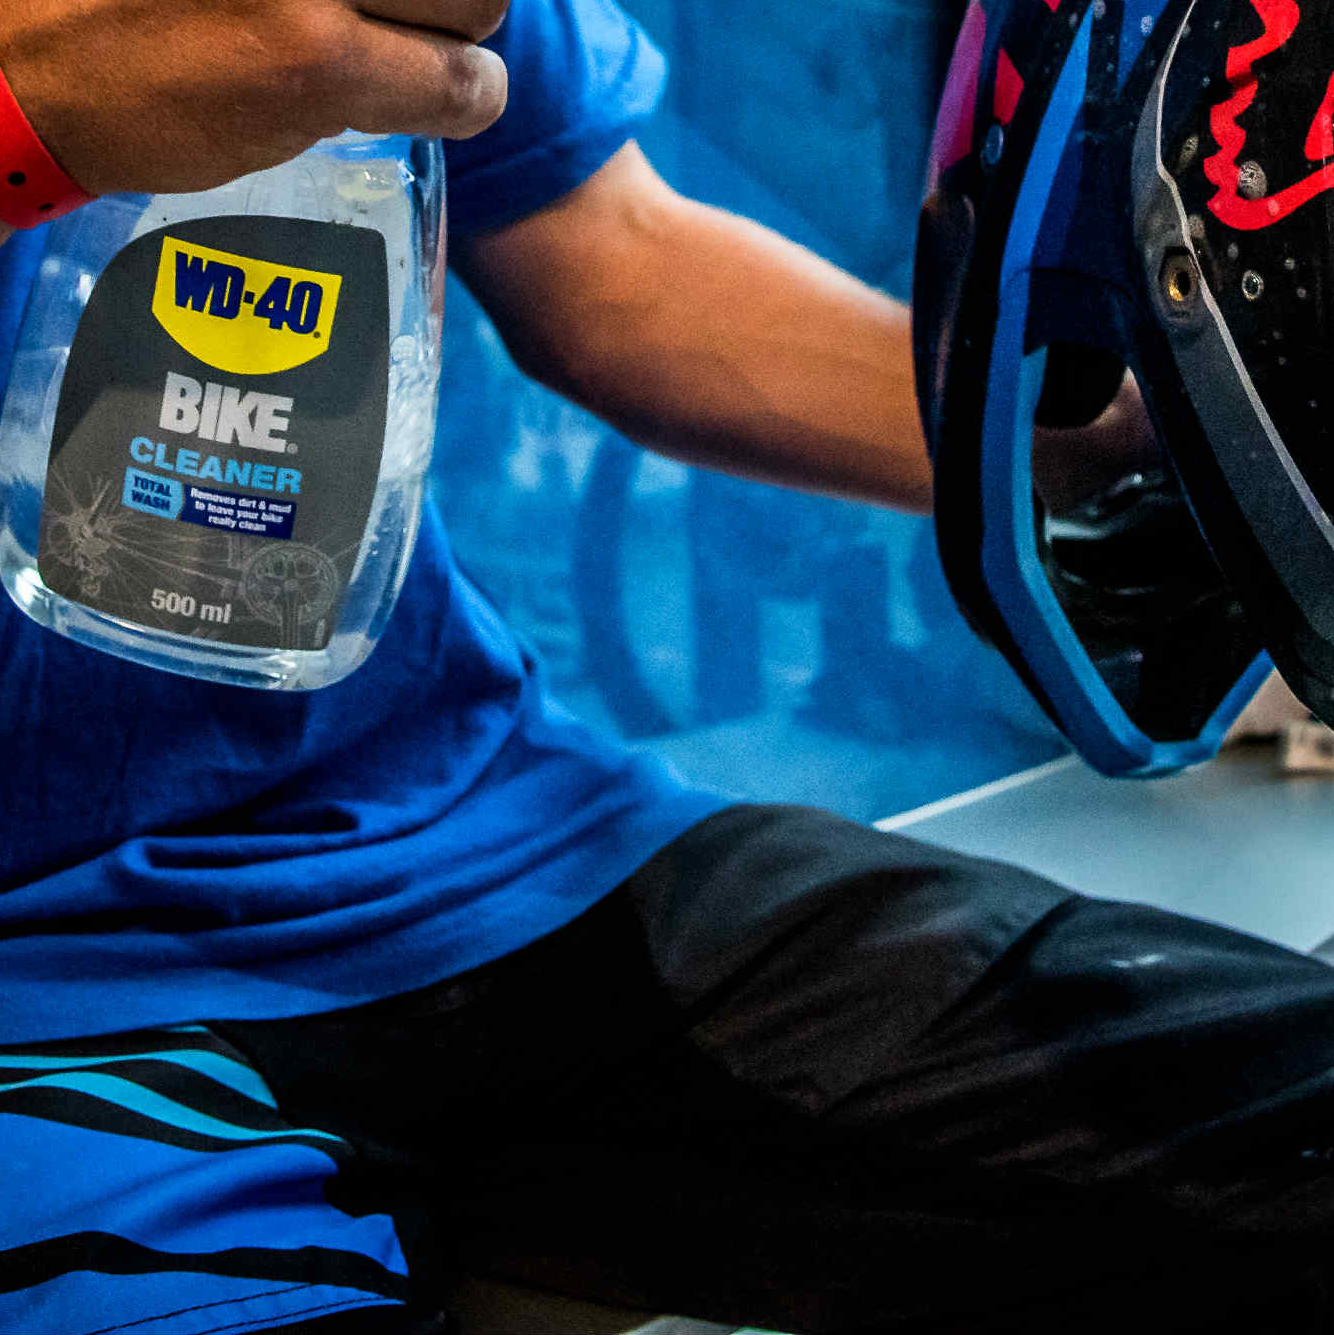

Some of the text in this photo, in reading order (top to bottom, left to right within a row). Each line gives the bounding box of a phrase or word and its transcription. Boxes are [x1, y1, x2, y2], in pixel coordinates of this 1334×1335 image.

[174, 250, 323, 335] WD-40
[159, 371, 294, 454] BIKE
[130, 436, 303, 494] CLEANER
[133, 475, 172, 497] TOTAL
[132, 490, 171, 512] WASH
[190, 487, 236, 506] Removes
[238, 496, 257, 509] dirt
[195, 500, 206, 512] to
[207, 502, 234, 516] leave
[236, 509, 259, 521] your
[208, 515, 267, 532] really clean
[151, 588, 233, 624] 500 ml
